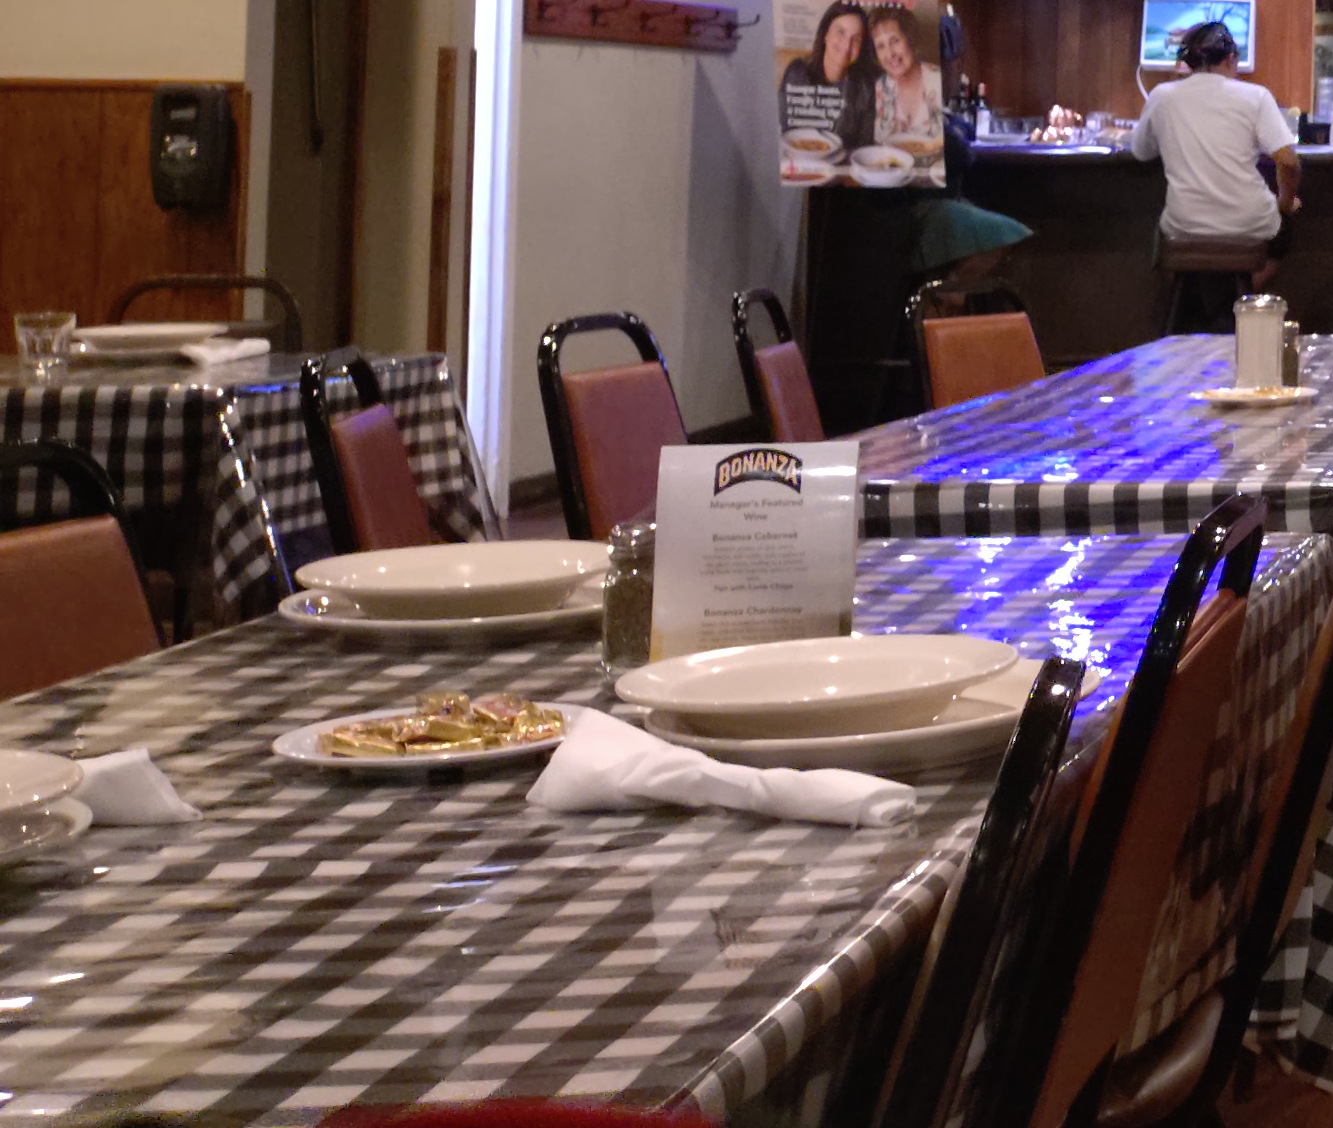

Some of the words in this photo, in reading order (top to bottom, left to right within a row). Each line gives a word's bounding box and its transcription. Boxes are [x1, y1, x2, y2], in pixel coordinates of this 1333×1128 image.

[719, 450, 799, 488] BONANZA
[710, 499, 759, 510] Manager's
[762, 498, 803, 508] Featured
[743, 513, 768, 521] Wine
[712, 533, 752, 542] Bonanza
